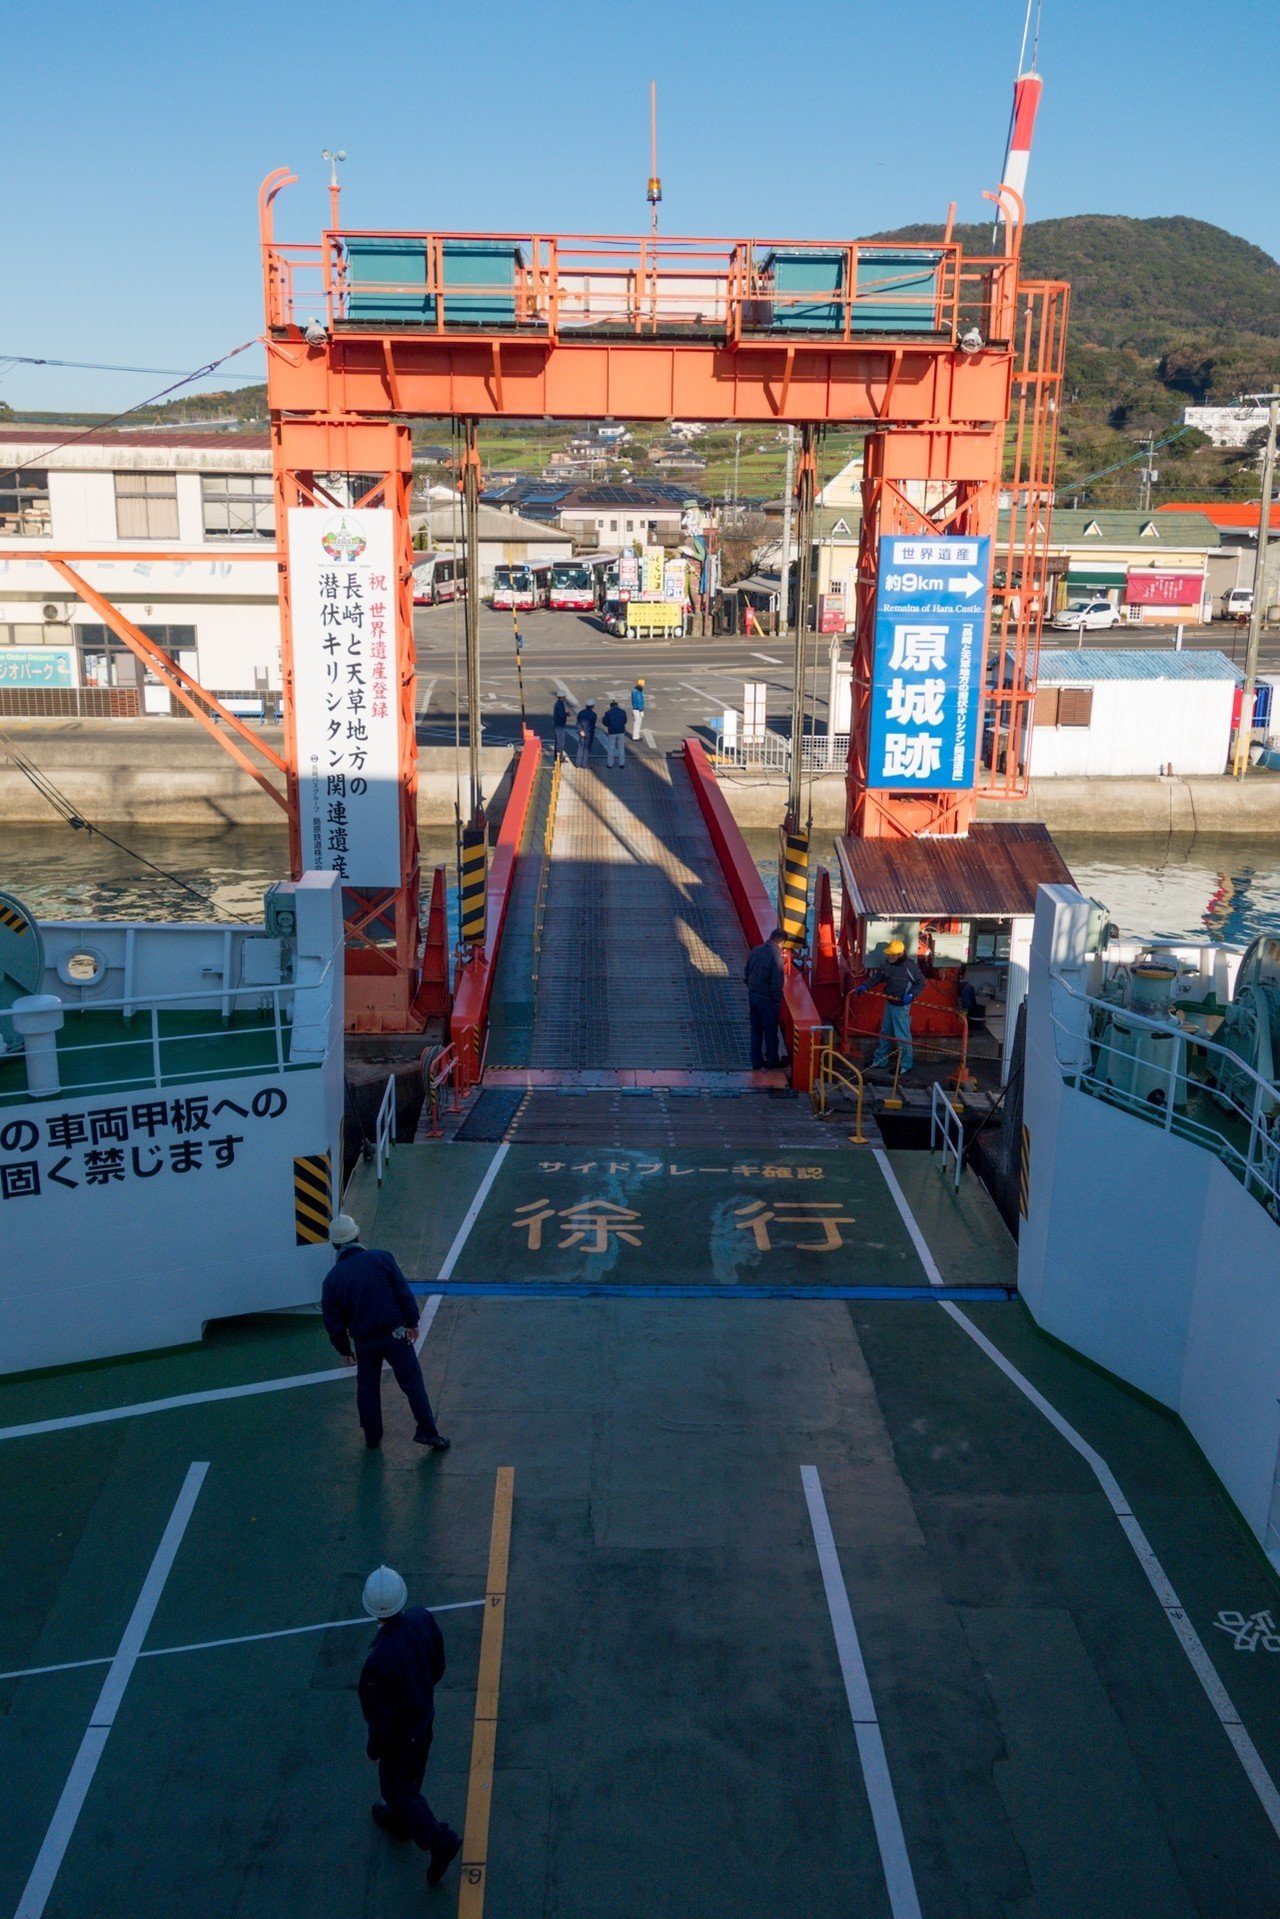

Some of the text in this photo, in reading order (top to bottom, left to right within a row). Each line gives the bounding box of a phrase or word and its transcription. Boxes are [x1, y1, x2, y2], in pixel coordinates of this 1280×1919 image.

[885, 573, 943, 592] 約9km
[902, 547, 970, 561] 世界遺産
[883, 603, 982, 614] Remains of Hara Castle
[368, 572, 389, 718] 祝 世界遺産登録
[342, 572, 369, 797] 長崎と天草地方の
[882, 624, 950, 779] 原城跡
[318, 573, 350, 880] 潜伏キリシタン関連遺産
[0, 1087, 288, 1153] の車両甲板への
[0, 1134, 244, 1200] 固く禁じます
[538, 1161, 826, 1180] サイドブレーキ確認
